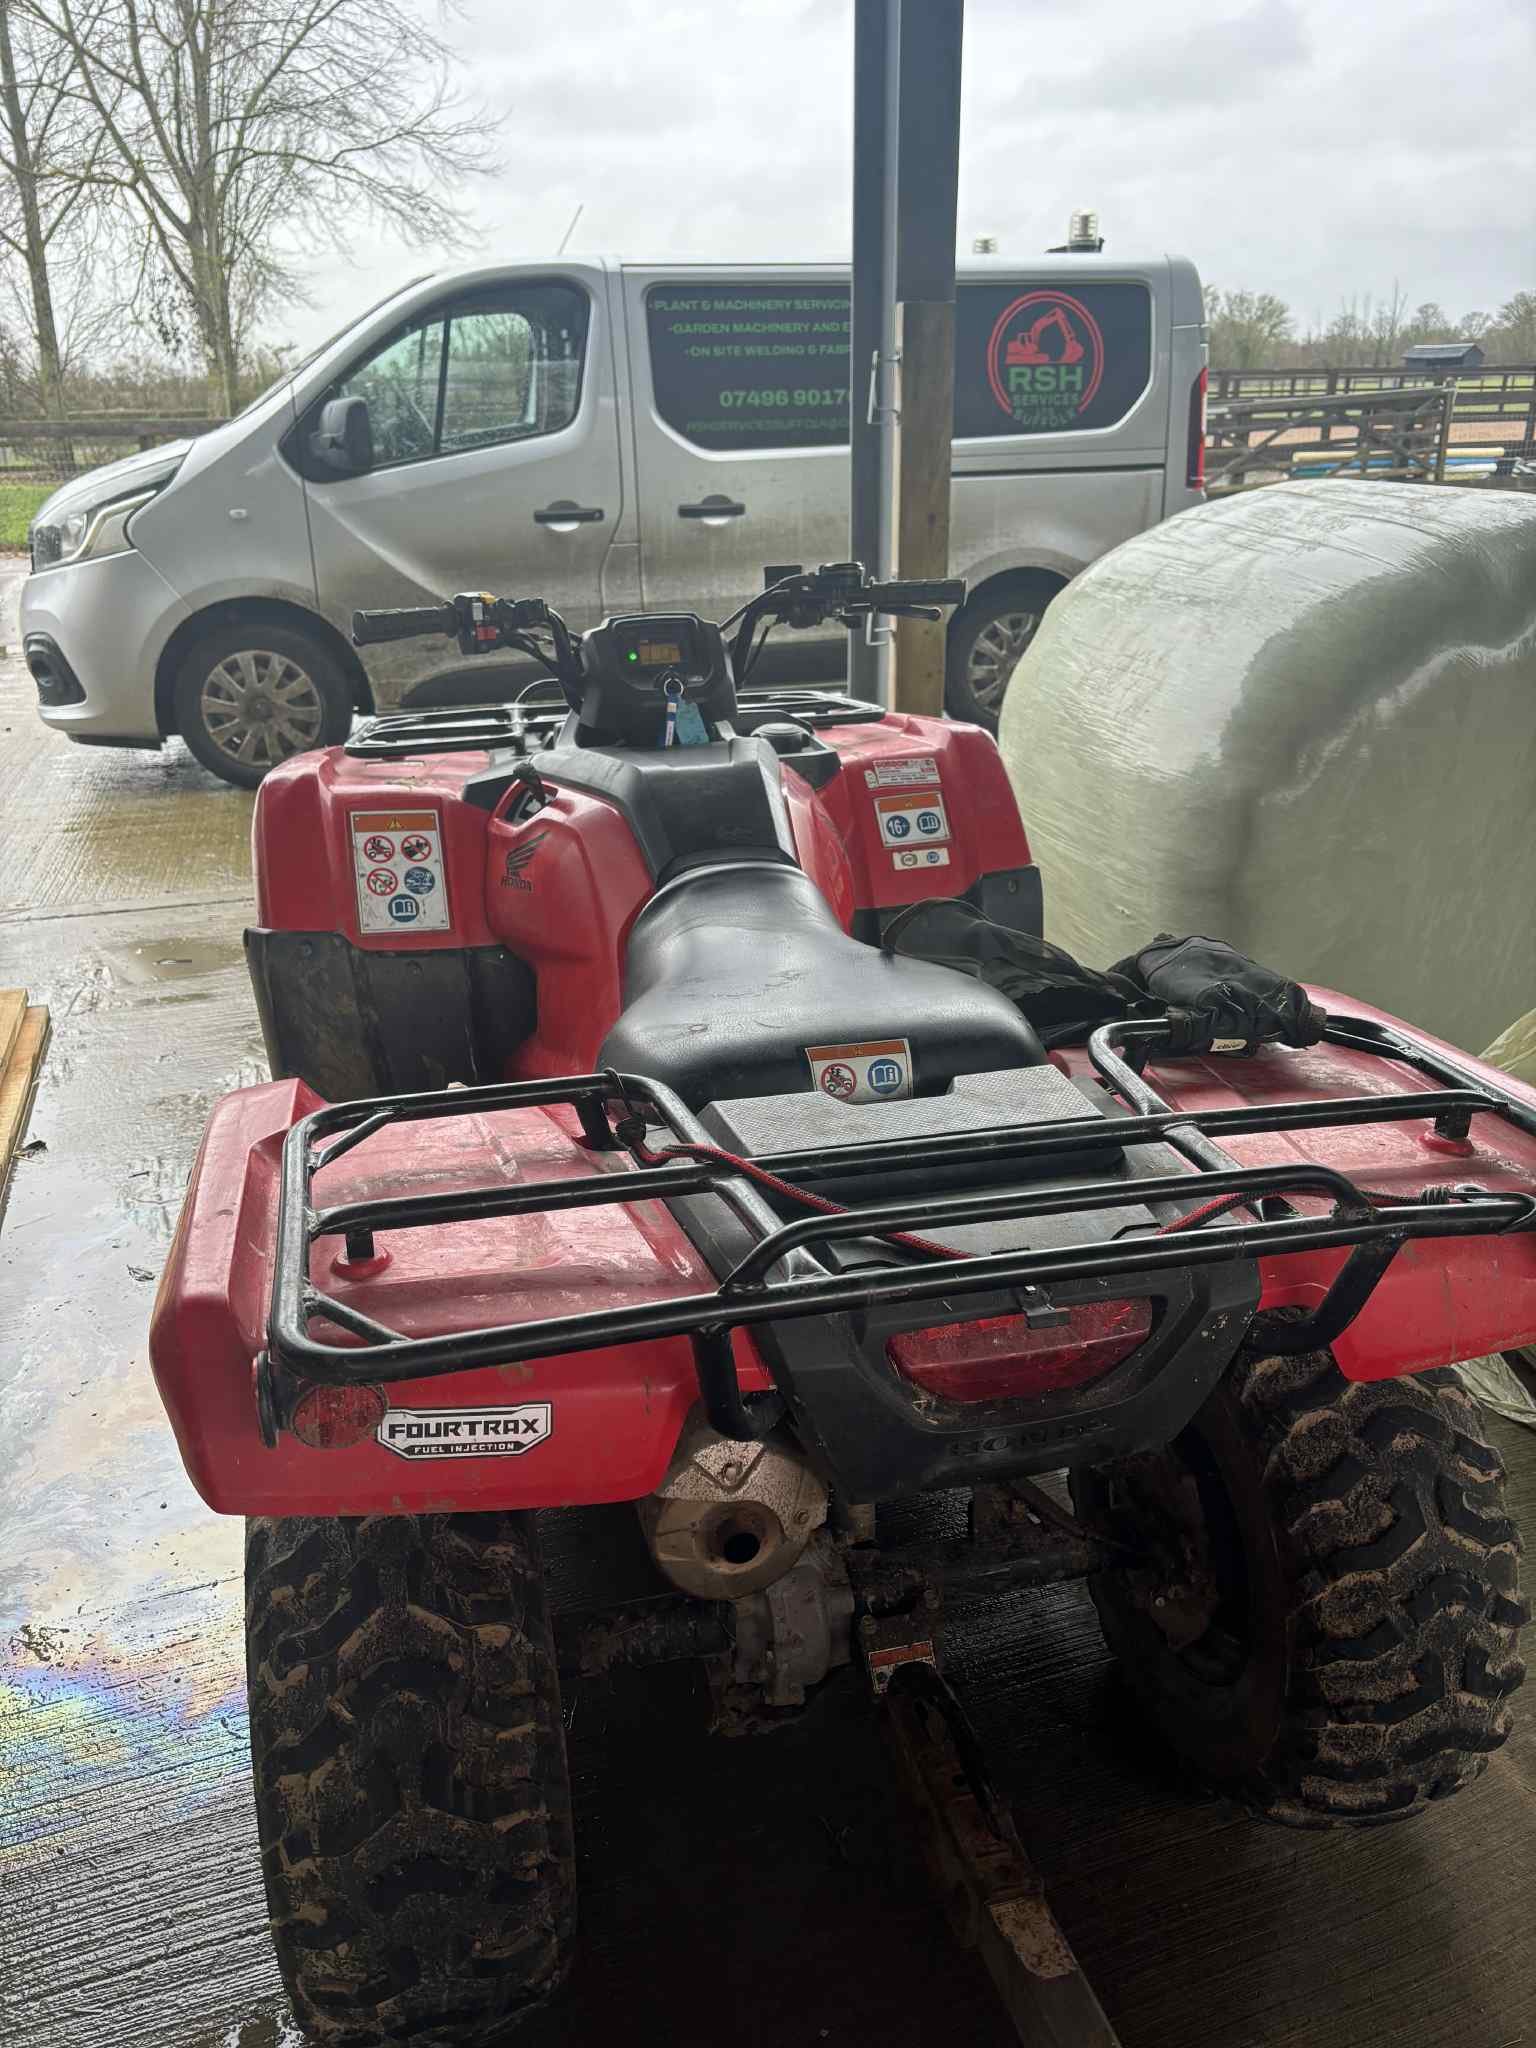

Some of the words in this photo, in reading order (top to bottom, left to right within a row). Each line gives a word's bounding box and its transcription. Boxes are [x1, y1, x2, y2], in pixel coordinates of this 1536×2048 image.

[714, 300, 792, 311] MACHINERY
[733, 322, 809, 333] MACHINERY
[812, 321, 841, 332] AND
[713, 345, 743, 357] SITE
[744, 345, 805, 356] WELDING
[1008, 366, 1083, 392] RSH
[719, 390, 789, 408] 07496
[793, 388, 850, 406] 9017
[1012, 393, 1079, 407] SERVICES
[388, 1418, 540, 1440] FOURTRAX
[414, 1446, 445, 1454] FUEL
[450, 1443, 515, 1453] INJECTION
